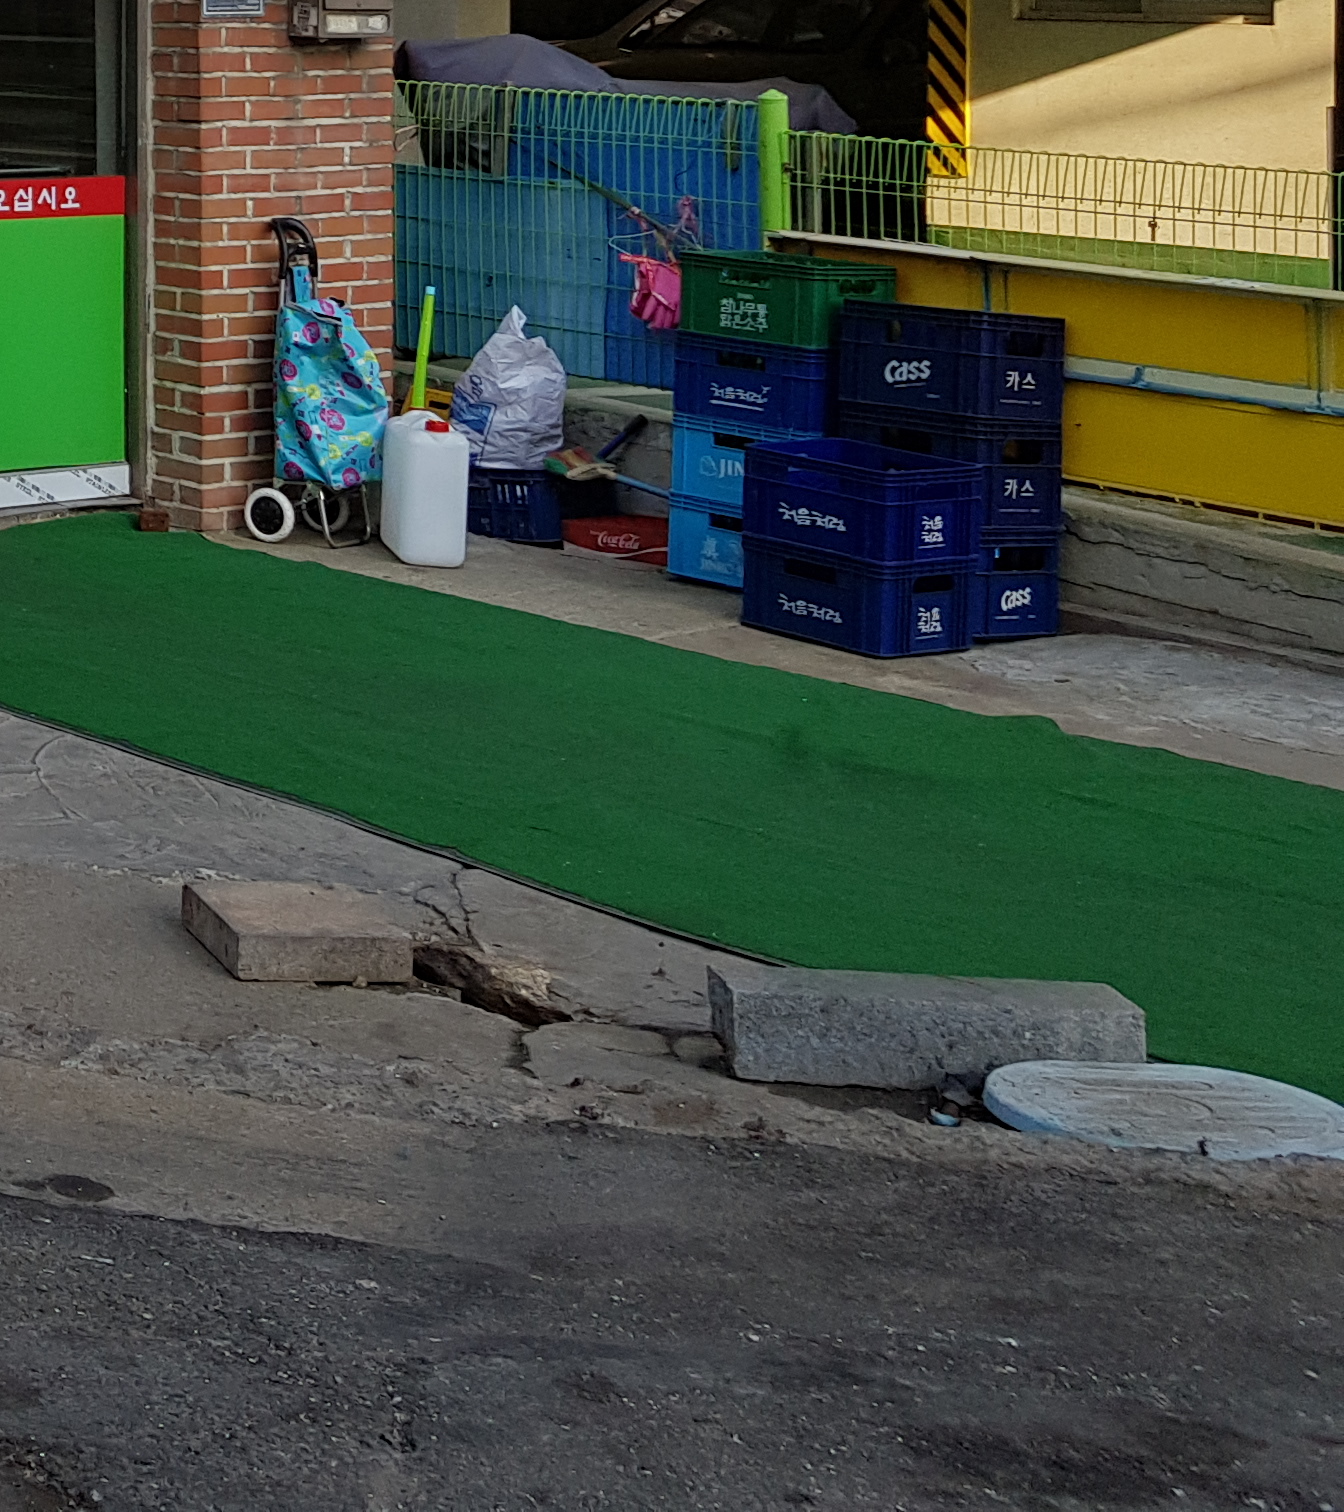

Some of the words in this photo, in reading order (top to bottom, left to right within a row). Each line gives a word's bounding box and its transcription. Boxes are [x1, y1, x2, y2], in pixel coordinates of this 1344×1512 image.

[884, 359, 932, 384] Cass
[1005, 370, 1037, 391] 카스
[1003, 478, 1035, 500] 카스
[778, 501, 847, 532] 처음처럼
[778, 593, 843, 624] 처음처럼
[1000, 587, 1033, 612] Cass
